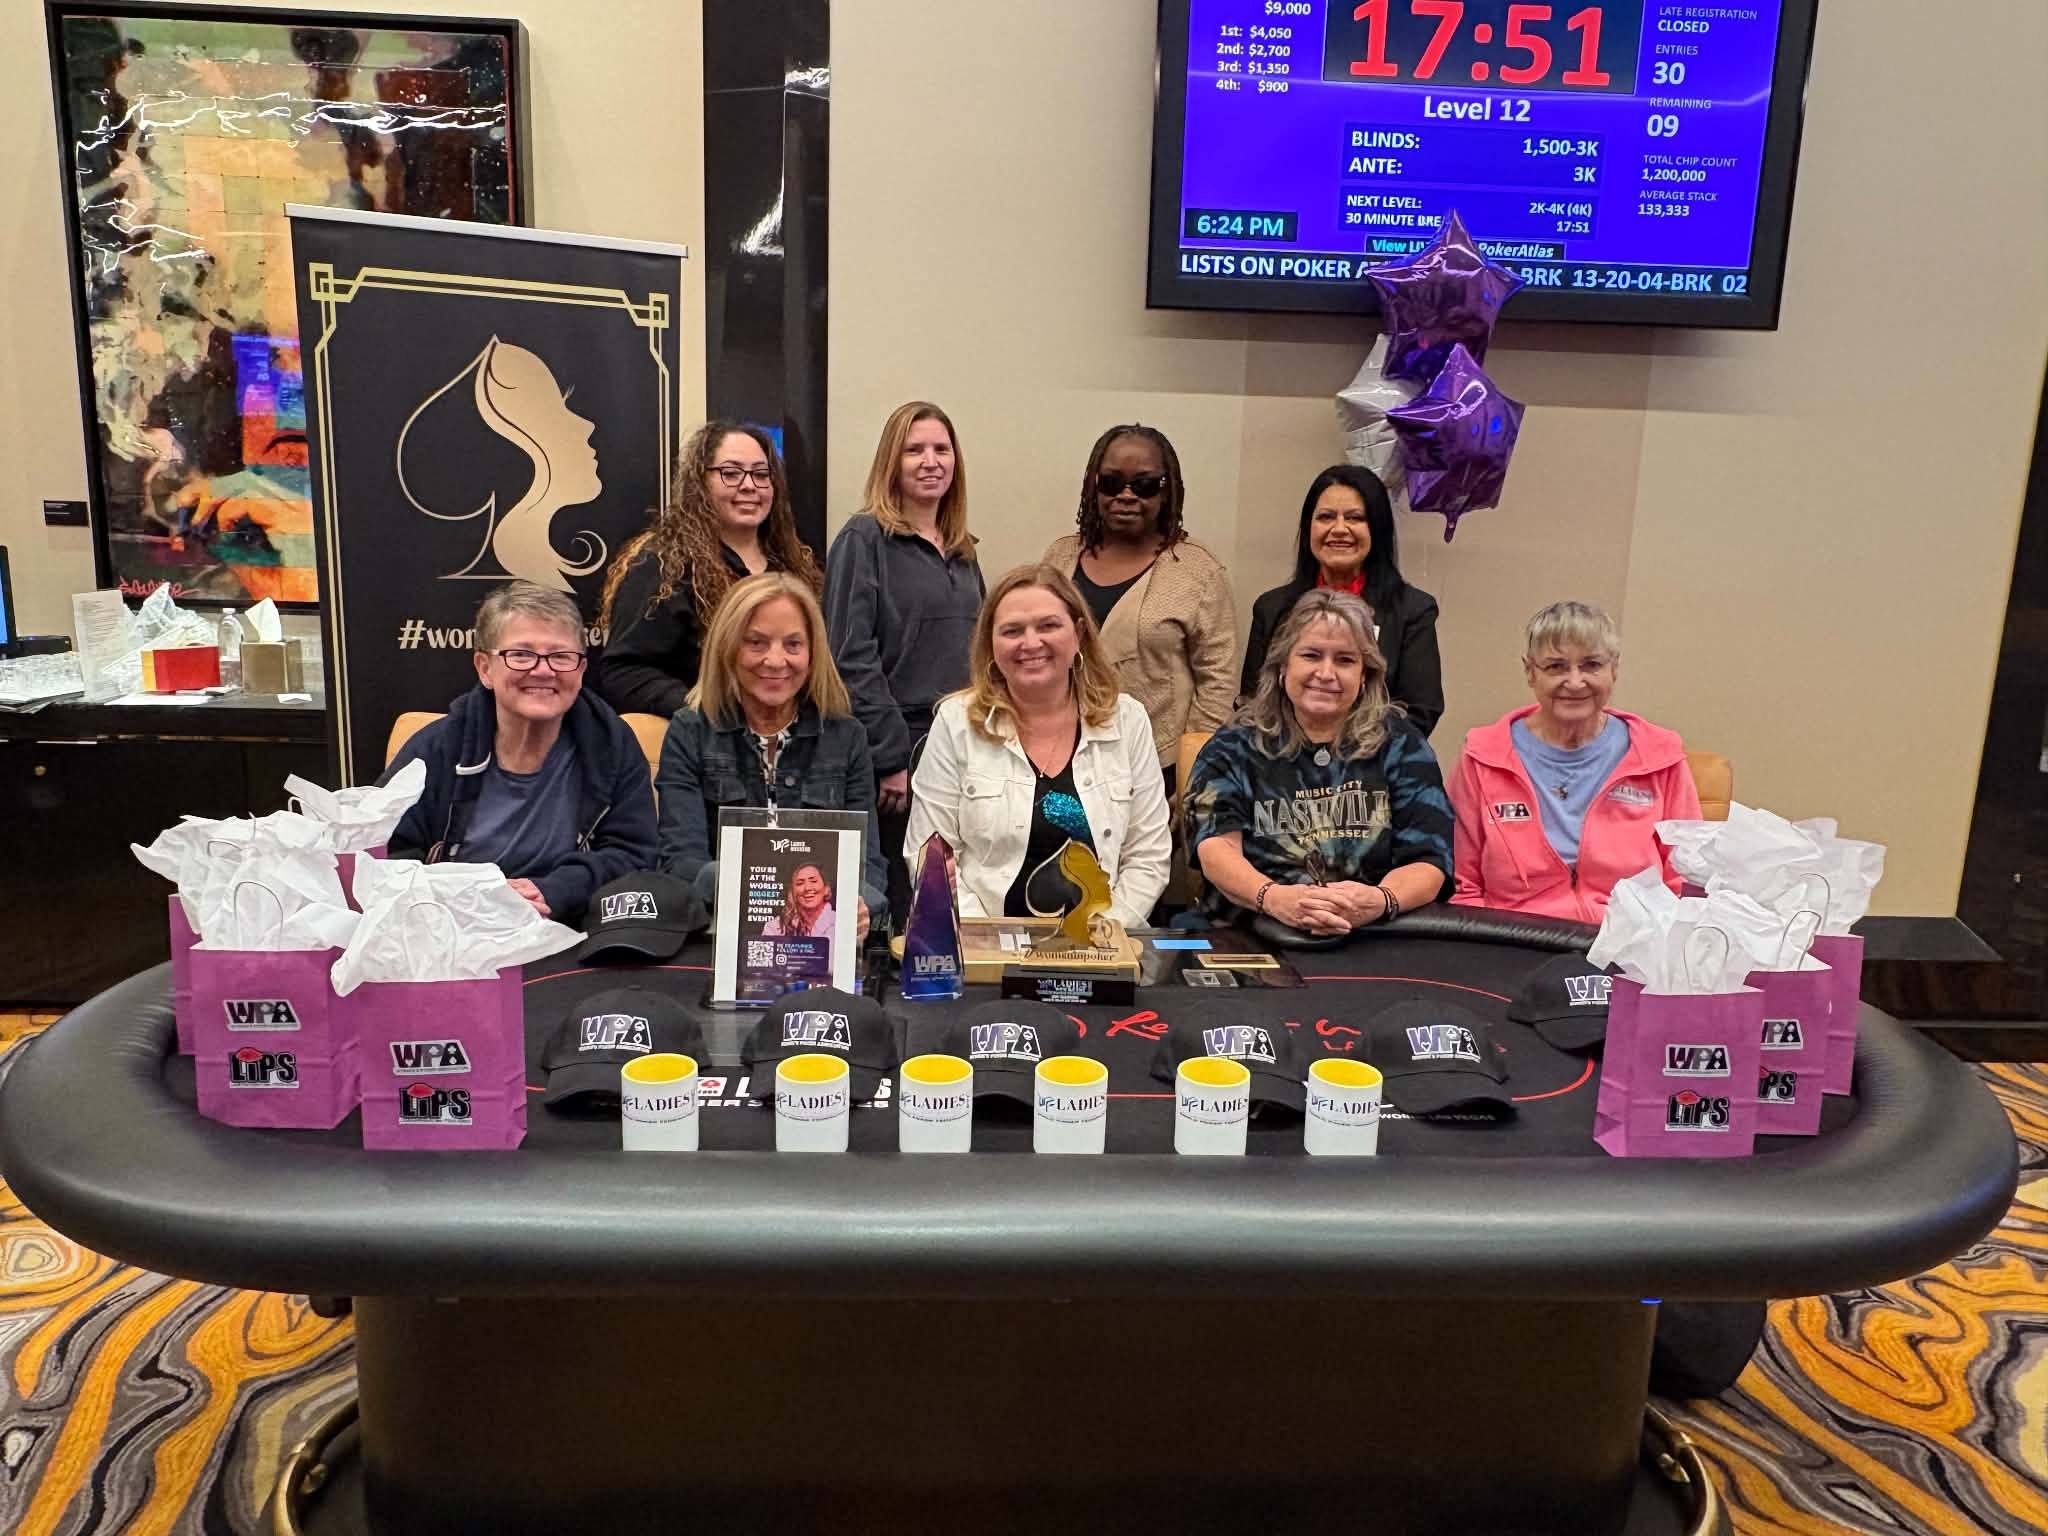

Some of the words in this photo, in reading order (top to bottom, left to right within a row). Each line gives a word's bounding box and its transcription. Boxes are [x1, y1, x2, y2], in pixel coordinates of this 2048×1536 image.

[1265, 1, 1311, 16] $9,000
[1659, 6, 1682, 16] LATE
[1685, 7, 1758, 20] REGISTRATION
[1220, 25, 1243, 37] 1st:
[1249, 25, 1292, 40] $4,050
[1657, 19, 1710, 33] CLOSED
[1216, 42, 1244, 55] 2nd:
[1248, 43, 1291, 57] $2,700
[1350, 0, 1611, 87] 17:51
[1655, 44, 1699, 56] ENTRIES
[1217, 60, 1242, 73] 3rd:
[1247, 60, 1290, 76] $1,350
[1653, 61, 1686, 85] 30
[1216, 78, 1241, 91] 4th:
[1257, 79, 1289, 94] $900
[1423, 95, 1492, 120] Level
[1499, 99, 1532, 122] 12
[1649, 97, 1713, 110] REMAINING
[1646, 114, 1680, 138] 09
[1351, 130, 1421, 149] BLINDS:
[1522, 138, 1599, 157] 1,500-3K
[1348, 157, 1403, 175] ANTE:
[1573, 167, 1597, 183] 3K
[1643, 154, 1674, 165] TOTAL
[1675, 155, 1700, 166] CHIP
[1701, 157, 1738, 168] COUNT
[1641, 168, 1707, 183] 1,200,000
[1639, 189, 1685, 201] AVERAGE
[1687, 191, 1718, 202] STACK
[1346, 194, 1380, 208] NEXT
[1381, 196, 1423, 209] LEVEL:
[1529, 202, 1565, 217] 2K-4K
[1567, 203, 1593, 218] (4K)
[1637, 203, 1690, 217] 133,333
[1197, 214, 1244, 236] 6:24
[1249, 217, 1284, 237] PM
[1345, 212, 1362, 224] 30
[1364, 212, 1415, 227] MINUTE
[1417, 215, 1442, 228] BRE
[1556, 221, 1590, 233] 17:51
[1372, 239, 1407, 253] View
[1478, 242, 1554, 259] PokerAtlas
[1181, 255, 1234, 275] LISTS
[1240, 257, 1274, 277] ON
[1280, 259, 1351, 279] POKER
[1572, 268, 1712, 292] 13-20-04-BRK
[1721, 275, 1748, 294] 02
[1295, 787, 1333, 799] MUSIC
[914, 954, 957, 973] WPA
[226, 1001, 298, 1024] WPA
[580, 1014, 652, 1049] WPA
[784, 1011, 851, 1046] WPA
[970, 1023, 1041, 1056] WPA
[1203, 1025, 1276, 1059] WPA
[1406, 1025, 1481, 1055] WPA
[392, 1043, 468, 1068] WPA
[1668, 1046, 1729, 1070] WPA
[634, 1095, 690, 1111] LADIES
[787, 1094, 842, 1109] LADIES
[912, 1094, 964, 1110] LADIES
